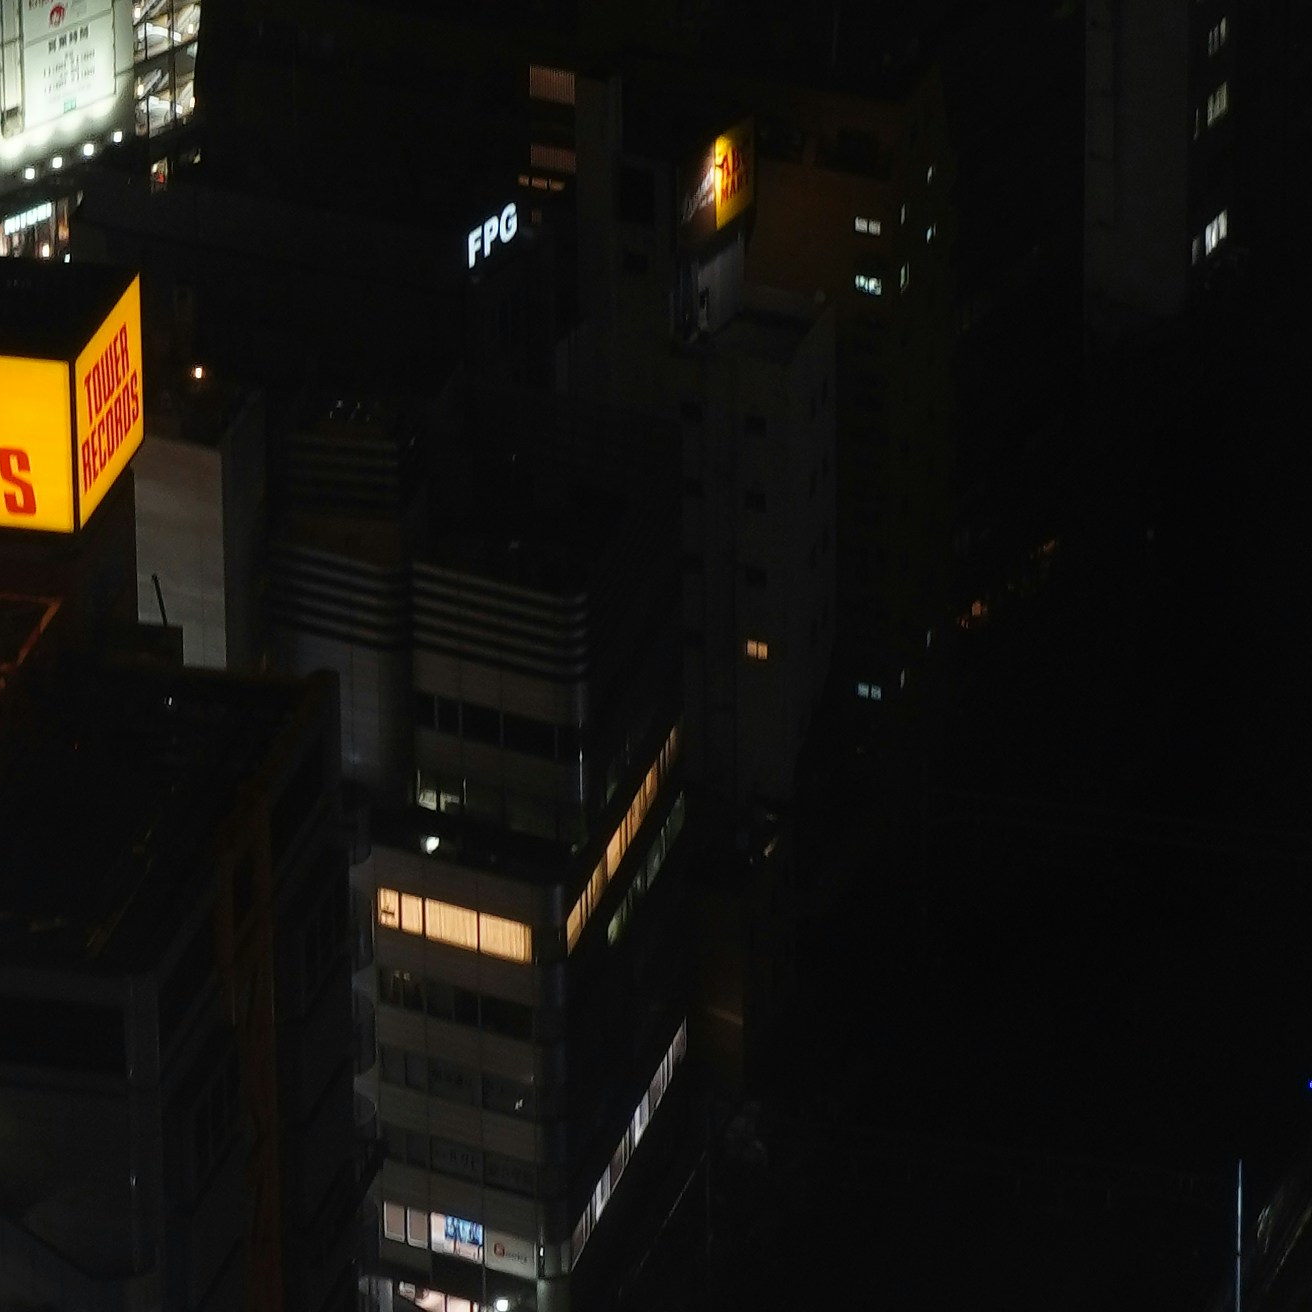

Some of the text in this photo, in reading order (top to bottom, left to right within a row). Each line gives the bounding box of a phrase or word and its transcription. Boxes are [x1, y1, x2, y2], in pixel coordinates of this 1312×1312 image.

[467, 202, 518, 269] FPG
[83, 321, 130, 426] TOWER
[81, 369, 140, 496] RECORDS
